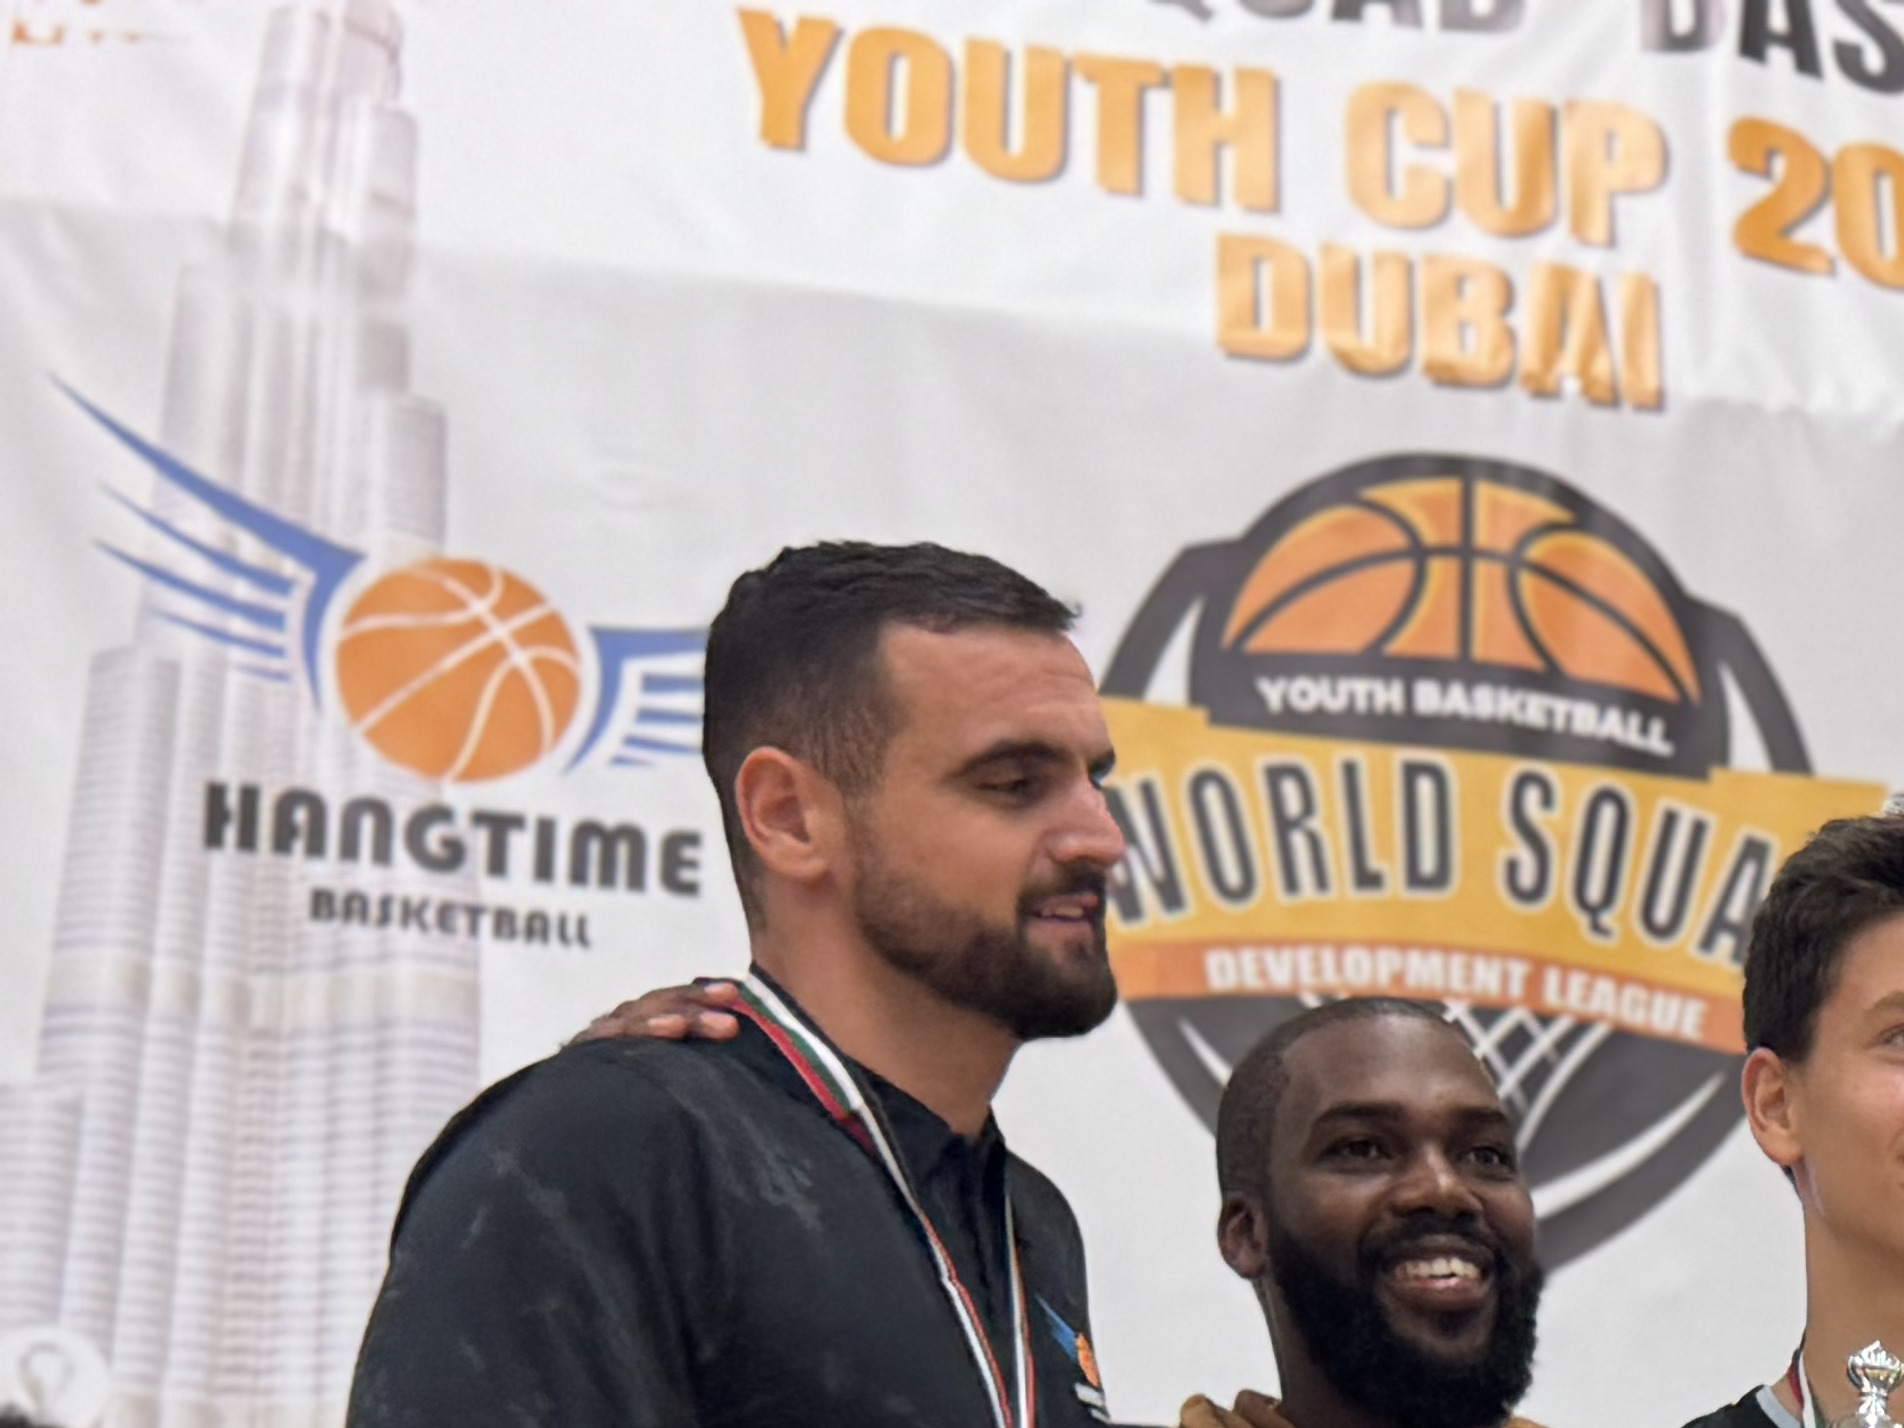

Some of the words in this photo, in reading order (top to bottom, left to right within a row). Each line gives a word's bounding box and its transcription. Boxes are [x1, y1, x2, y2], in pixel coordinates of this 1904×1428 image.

[737, 8, 1282, 213] YOUTH
[1345, 79, 1669, 247] CUP
[1216, 233, 1665, 411] DUBAI
[1256, 677, 1402, 716] YOUTH
[1413, 680, 1674, 756] BASKETBALL
[205, 781, 703, 897] HANGTIME
[1502, 768, 1775, 972] SQUA
[309, 888, 592, 949] BASKETBALL
[1205, 946, 1526, 997] DEVELOPMENT
[1543, 968, 1707, 1038] LEAGUE
